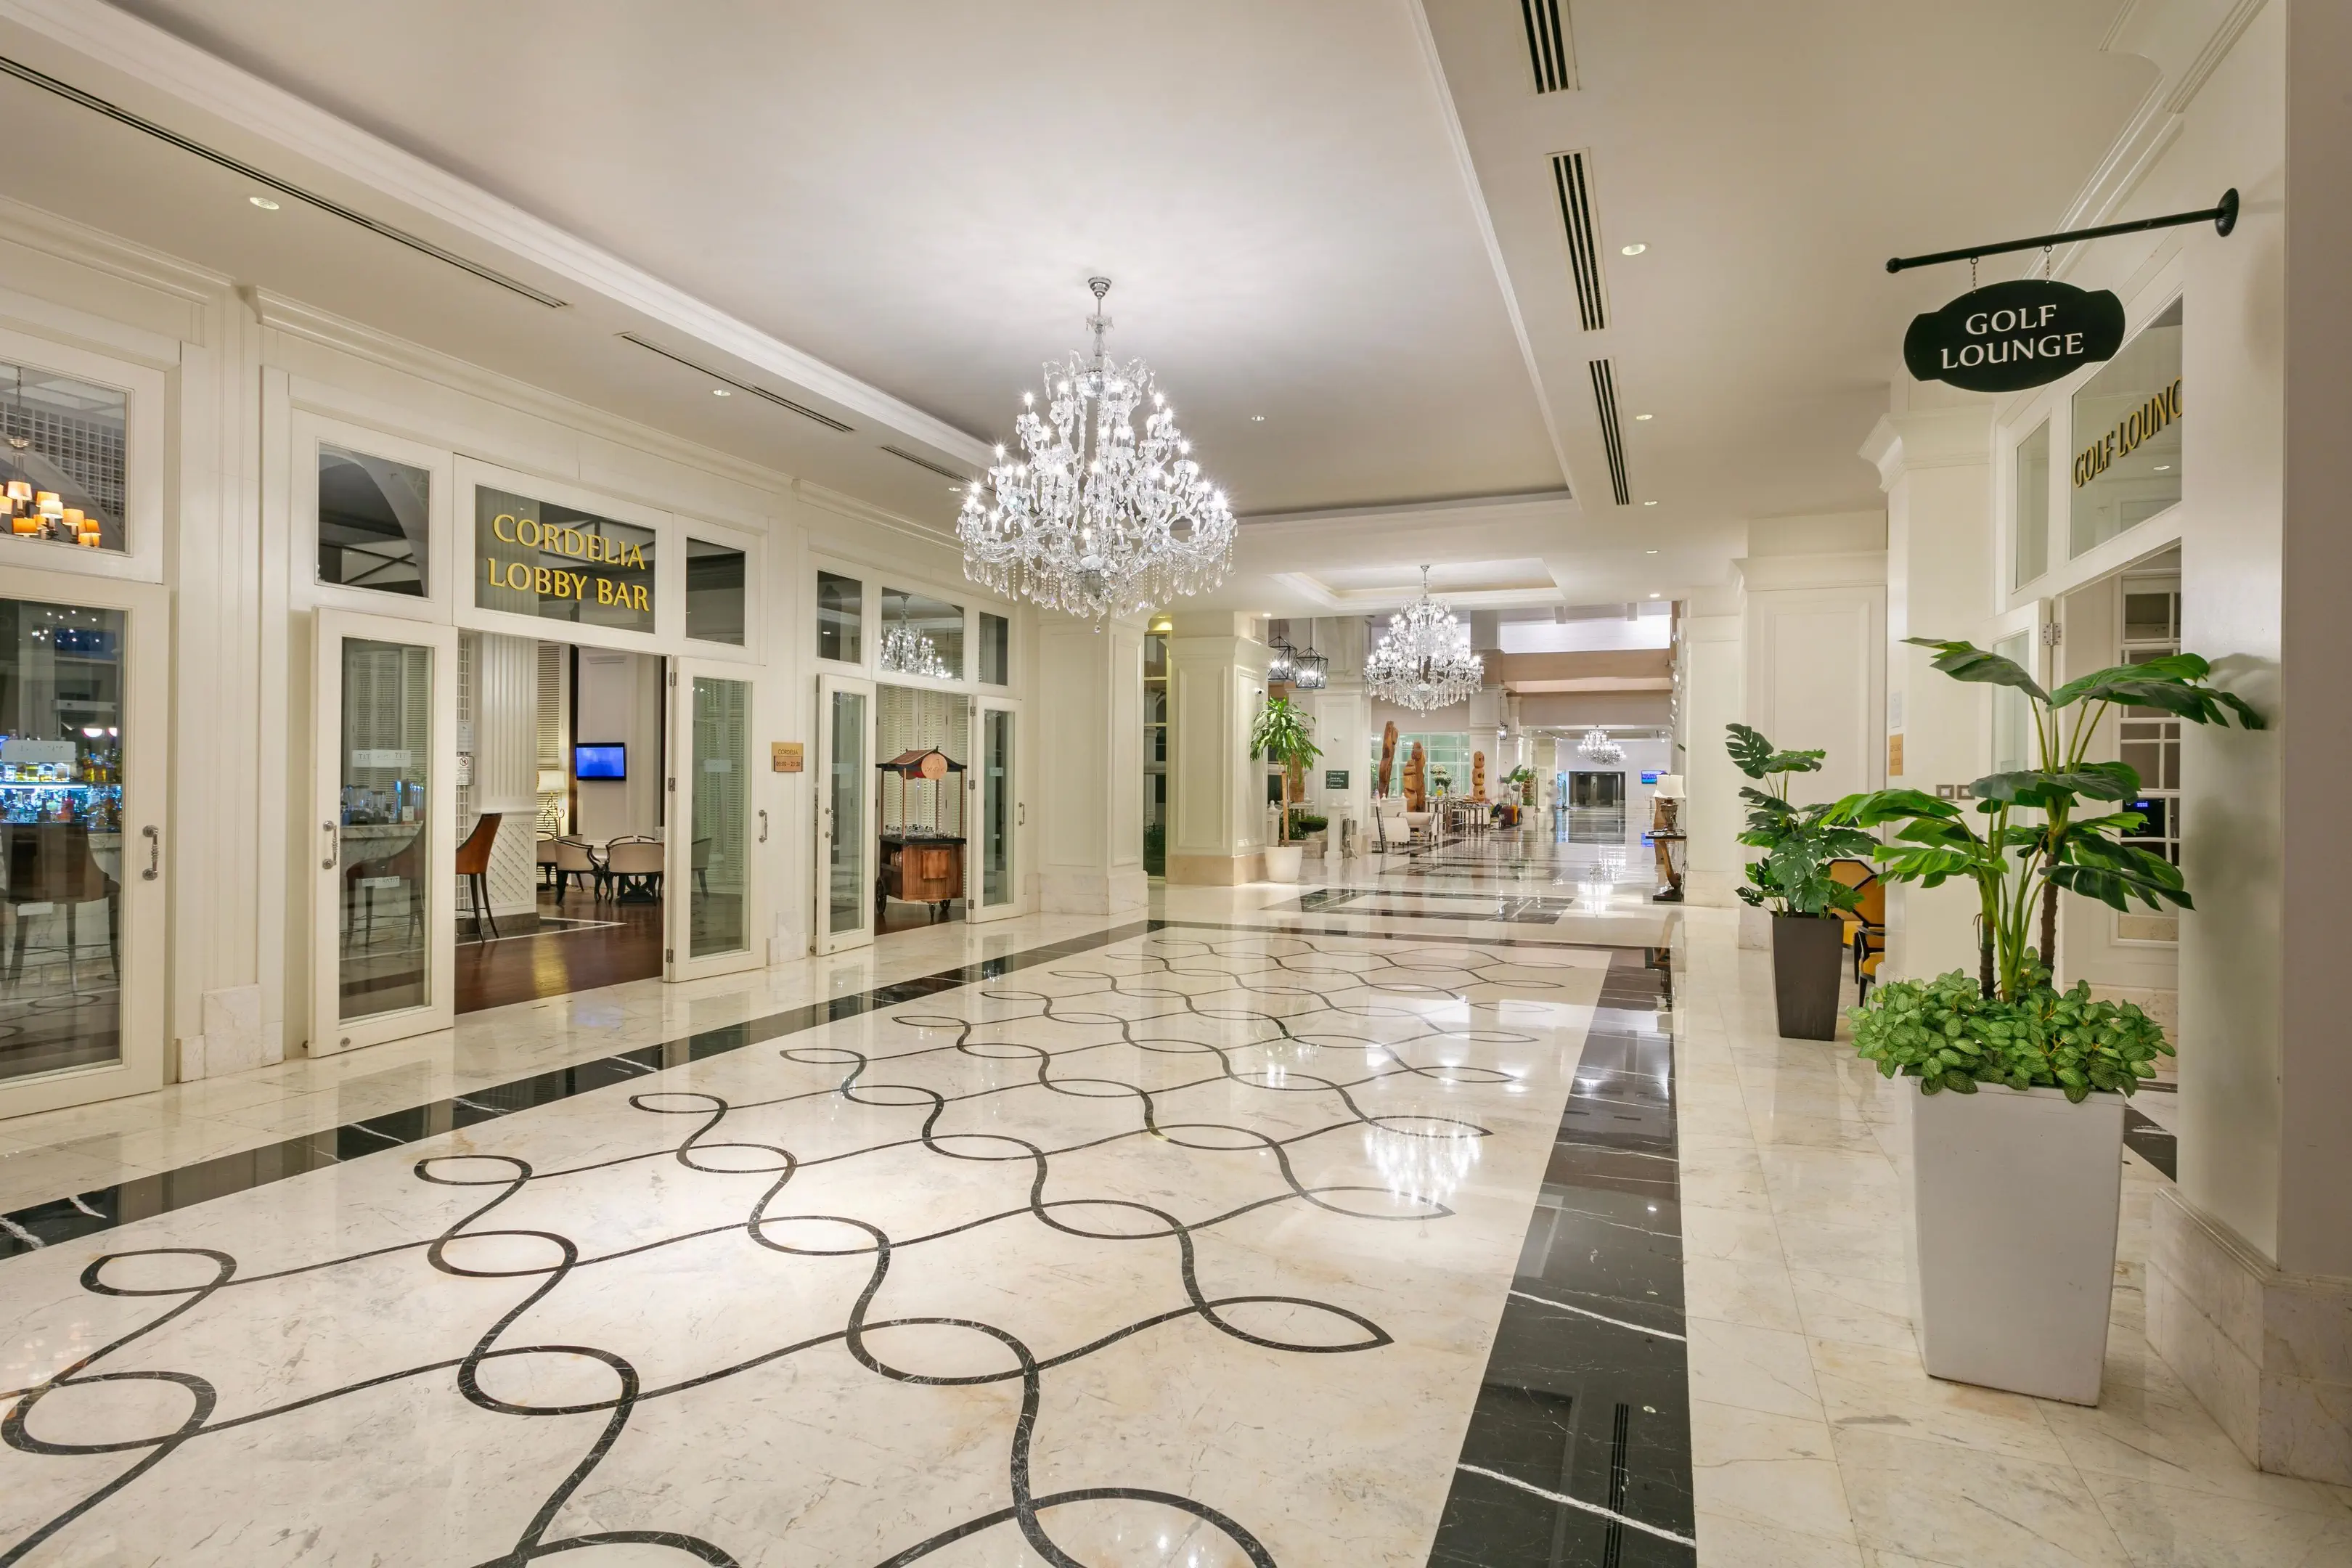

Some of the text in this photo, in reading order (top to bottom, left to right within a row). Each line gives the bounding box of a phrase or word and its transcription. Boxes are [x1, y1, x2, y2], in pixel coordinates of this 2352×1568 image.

[1965, 304, 2057, 335] GOLF
[1940, 333, 2084, 369] LOUNGE
[2073, 375, 2182, 489] GOLF LOUNG
[493, 514, 645, 570] CORDELIA
[487, 558, 649, 611] LOBBY BAR
